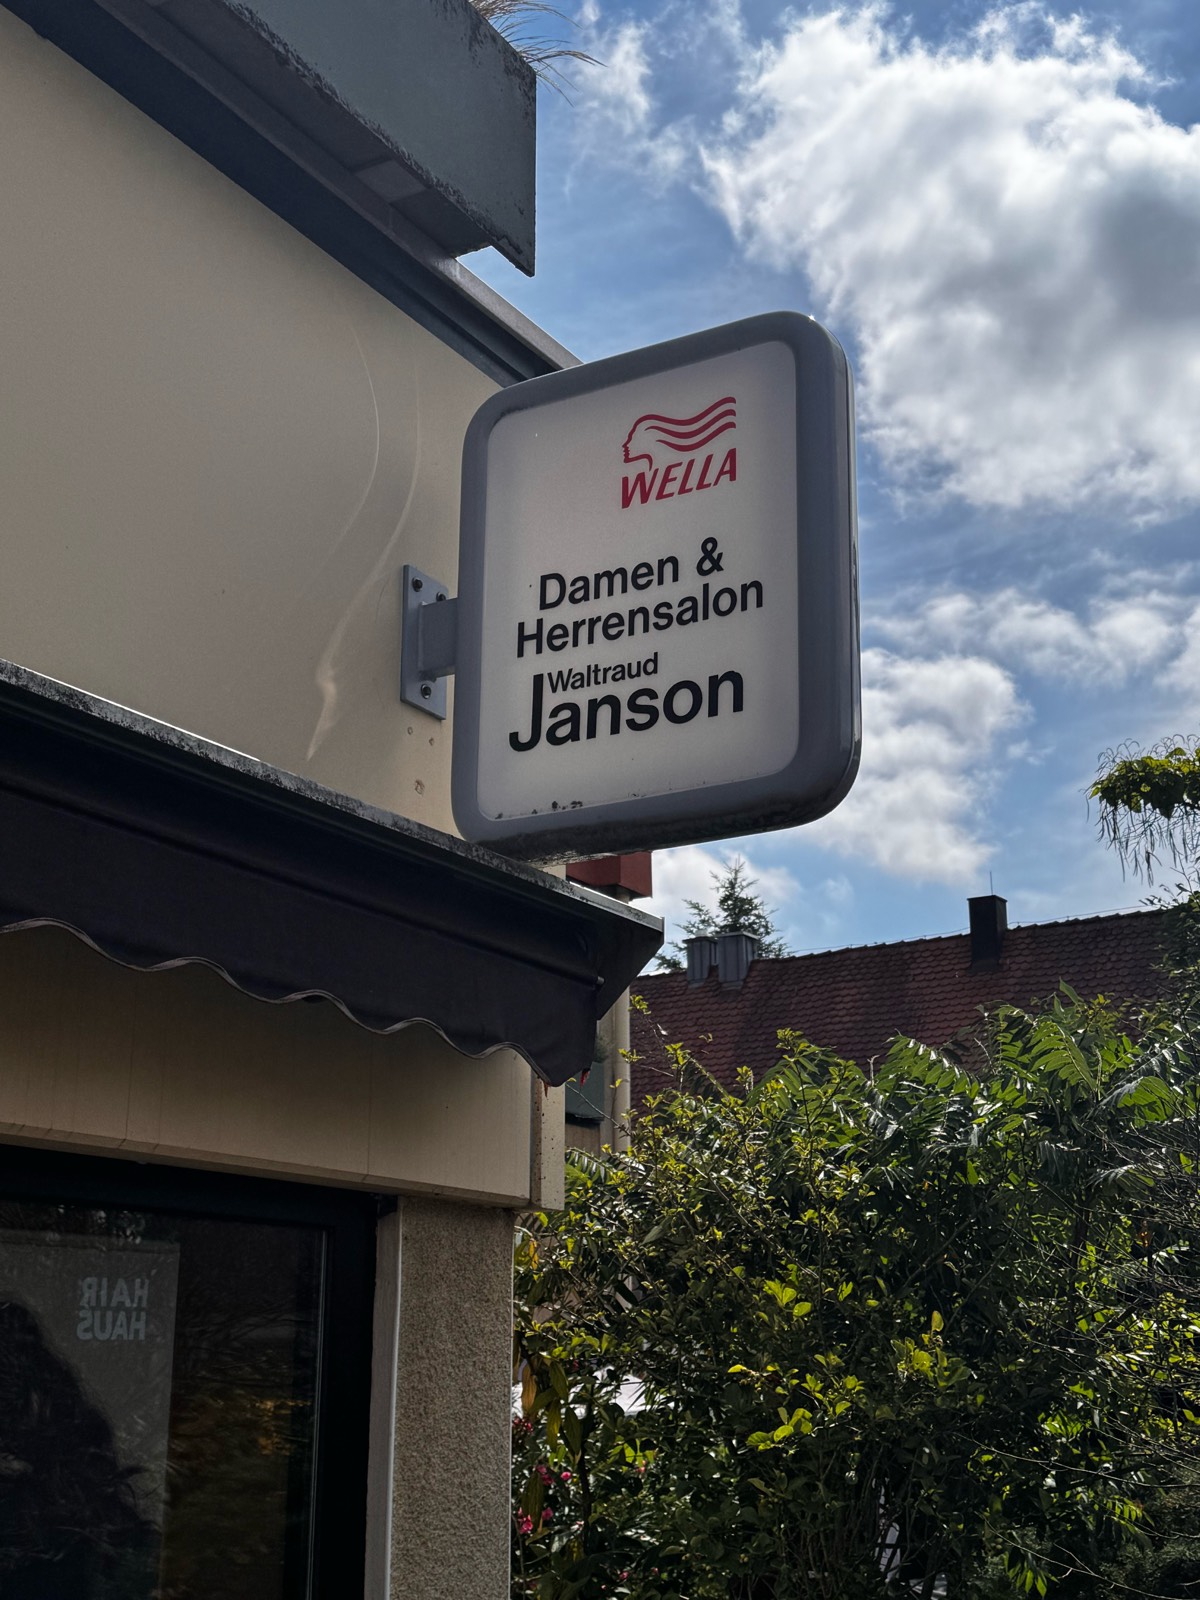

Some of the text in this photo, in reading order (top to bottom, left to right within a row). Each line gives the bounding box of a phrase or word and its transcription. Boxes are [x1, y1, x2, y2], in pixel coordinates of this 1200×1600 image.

[622, 448, 737, 509] WELLA
[540, 538, 724, 610] Damen &
[517, 580, 763, 658] Herrensalon
[548, 653, 659, 693] Waltraud
[510, 671, 743, 752] Janson
